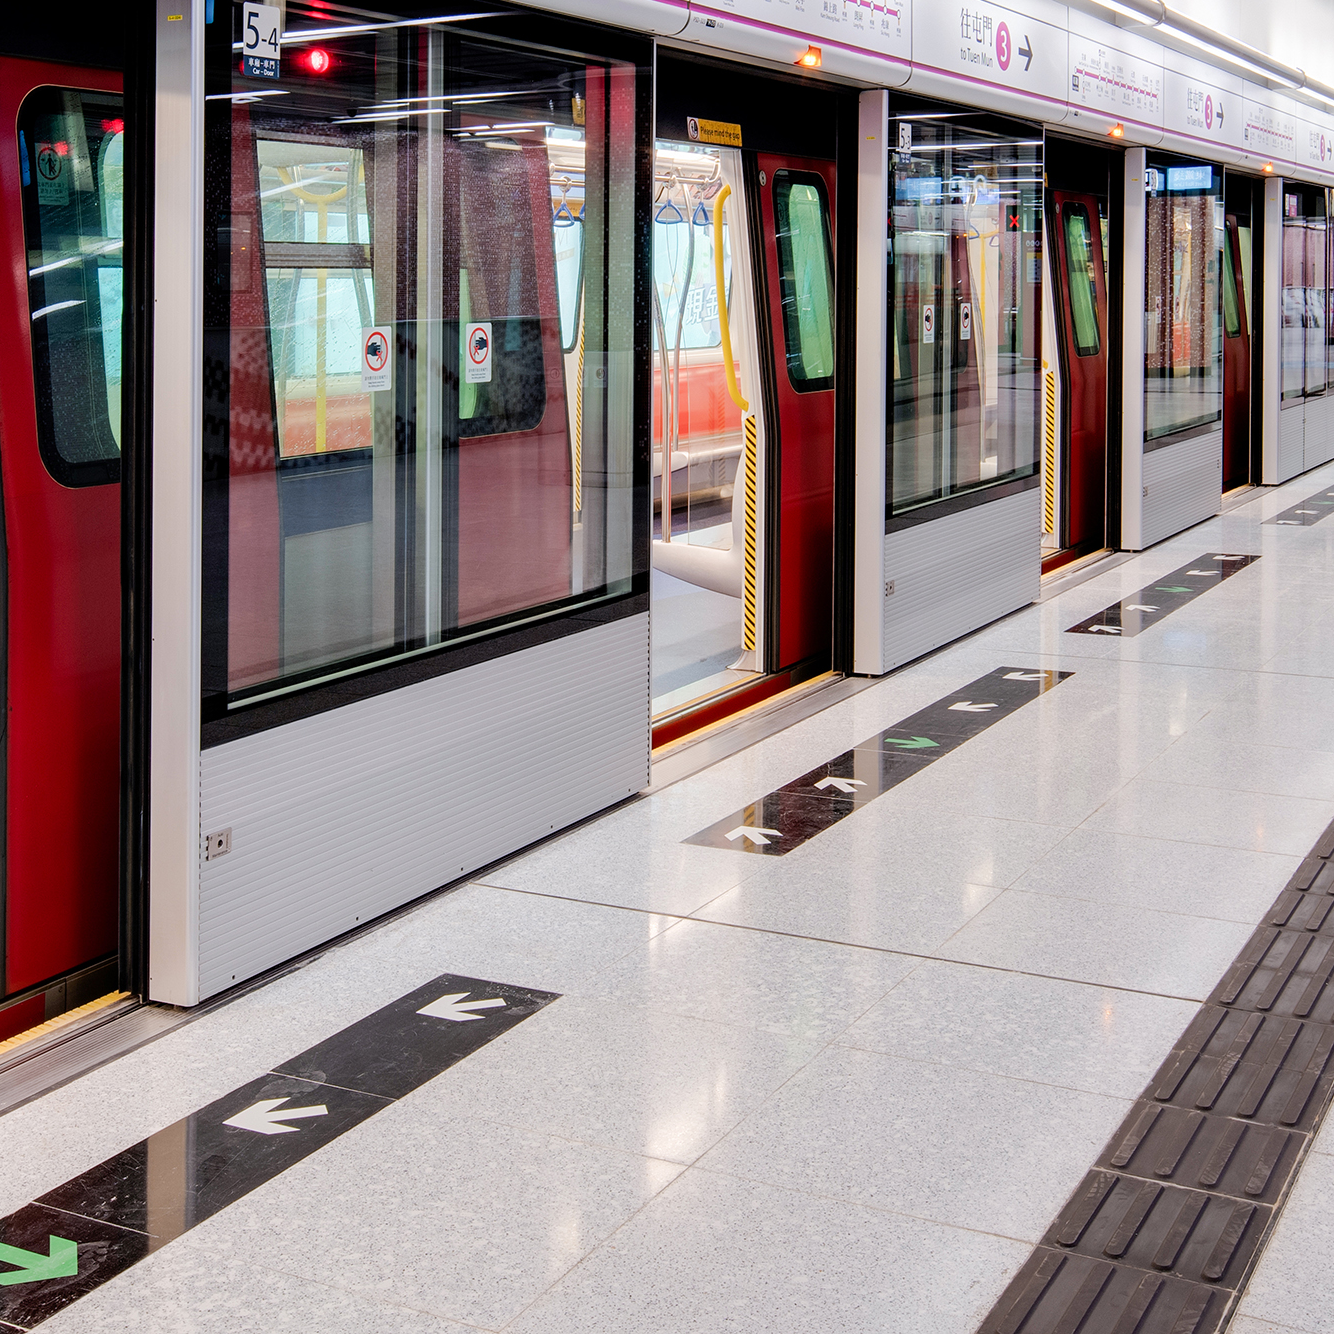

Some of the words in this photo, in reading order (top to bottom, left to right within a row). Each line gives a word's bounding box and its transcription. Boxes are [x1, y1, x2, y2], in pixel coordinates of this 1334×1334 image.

[246, 11, 278, 52] 5-4
[960, 8, 992, 47] 往屯門
[961, 47, 966, 60] to
[967, 48, 980, 64] Tuen
[981, 52, 993, 67] Mun
[1001, 30, 1007, 62] 3
[1207, 102, 1211, 123] 3
